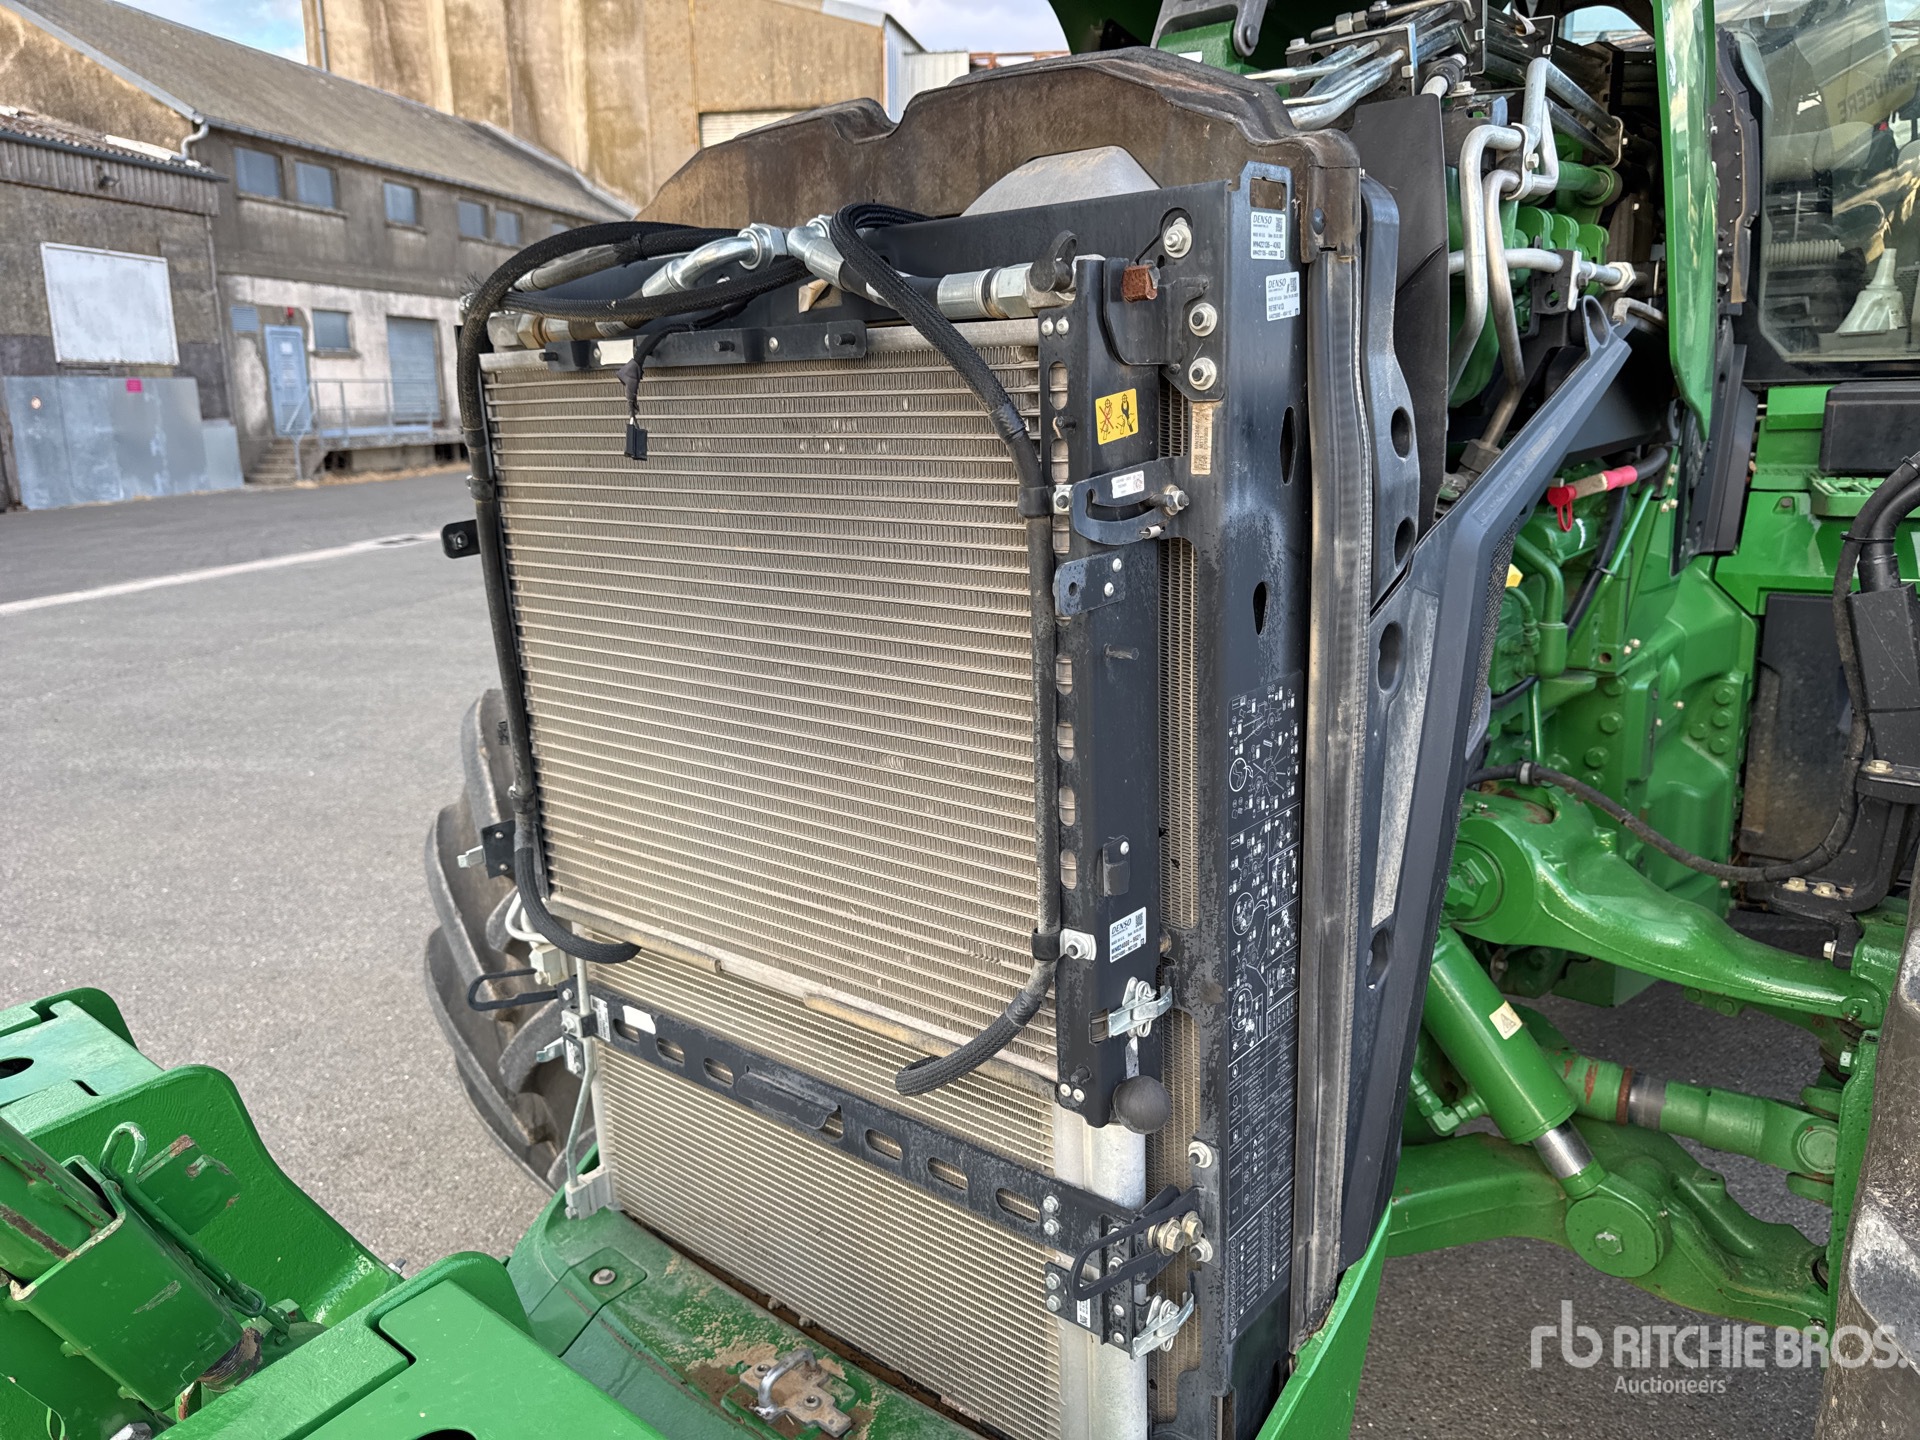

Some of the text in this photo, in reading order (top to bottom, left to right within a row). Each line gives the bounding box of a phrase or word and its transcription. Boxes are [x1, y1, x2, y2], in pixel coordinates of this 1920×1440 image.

[1253, 214, 1272, 224] DENSO
[1268, 278, 1287, 289] DENSO
[1111, 918, 1132, 935] DENSO
